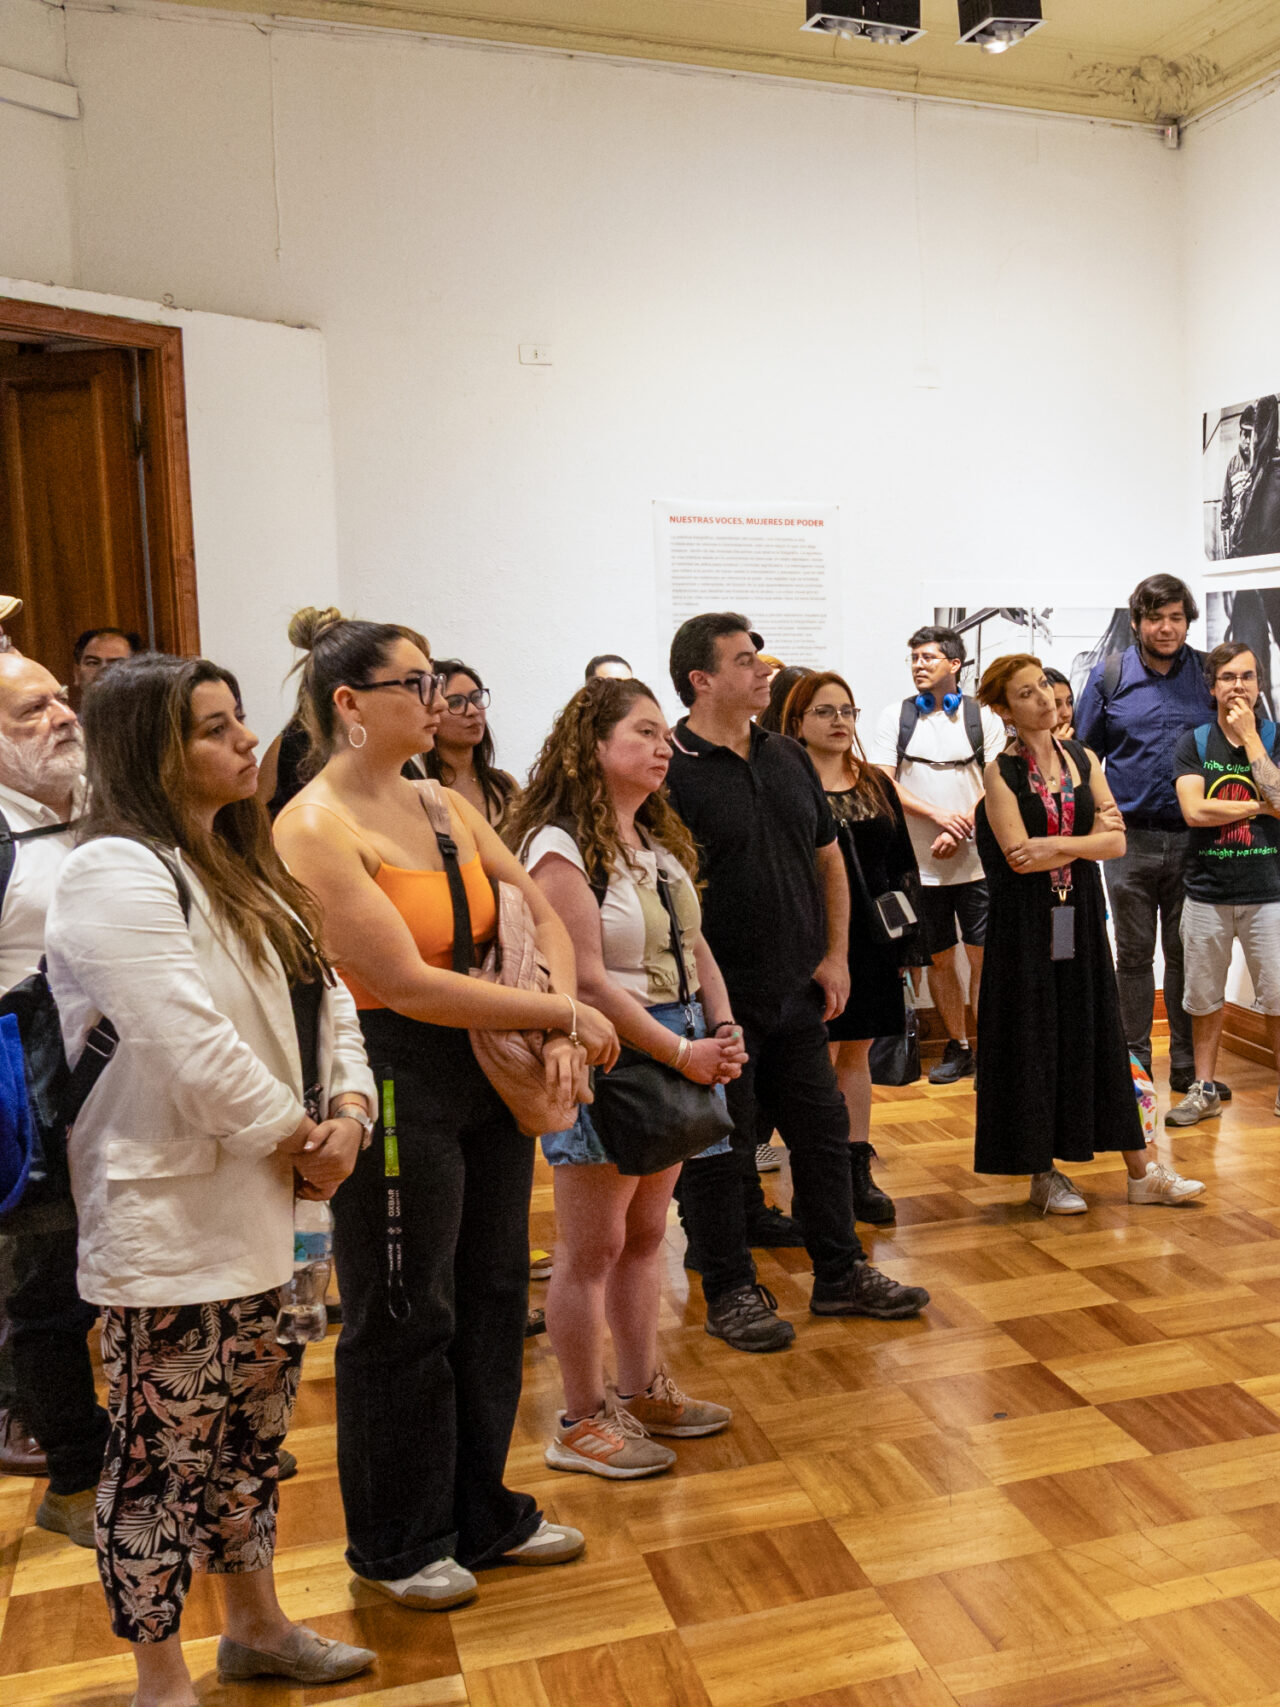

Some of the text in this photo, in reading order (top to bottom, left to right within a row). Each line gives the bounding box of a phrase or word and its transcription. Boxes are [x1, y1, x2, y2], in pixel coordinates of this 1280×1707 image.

[669, 516, 714, 524] NUESTRAS
[746, 518, 783, 526] MUJERES
[796, 519, 825, 527] PODER
